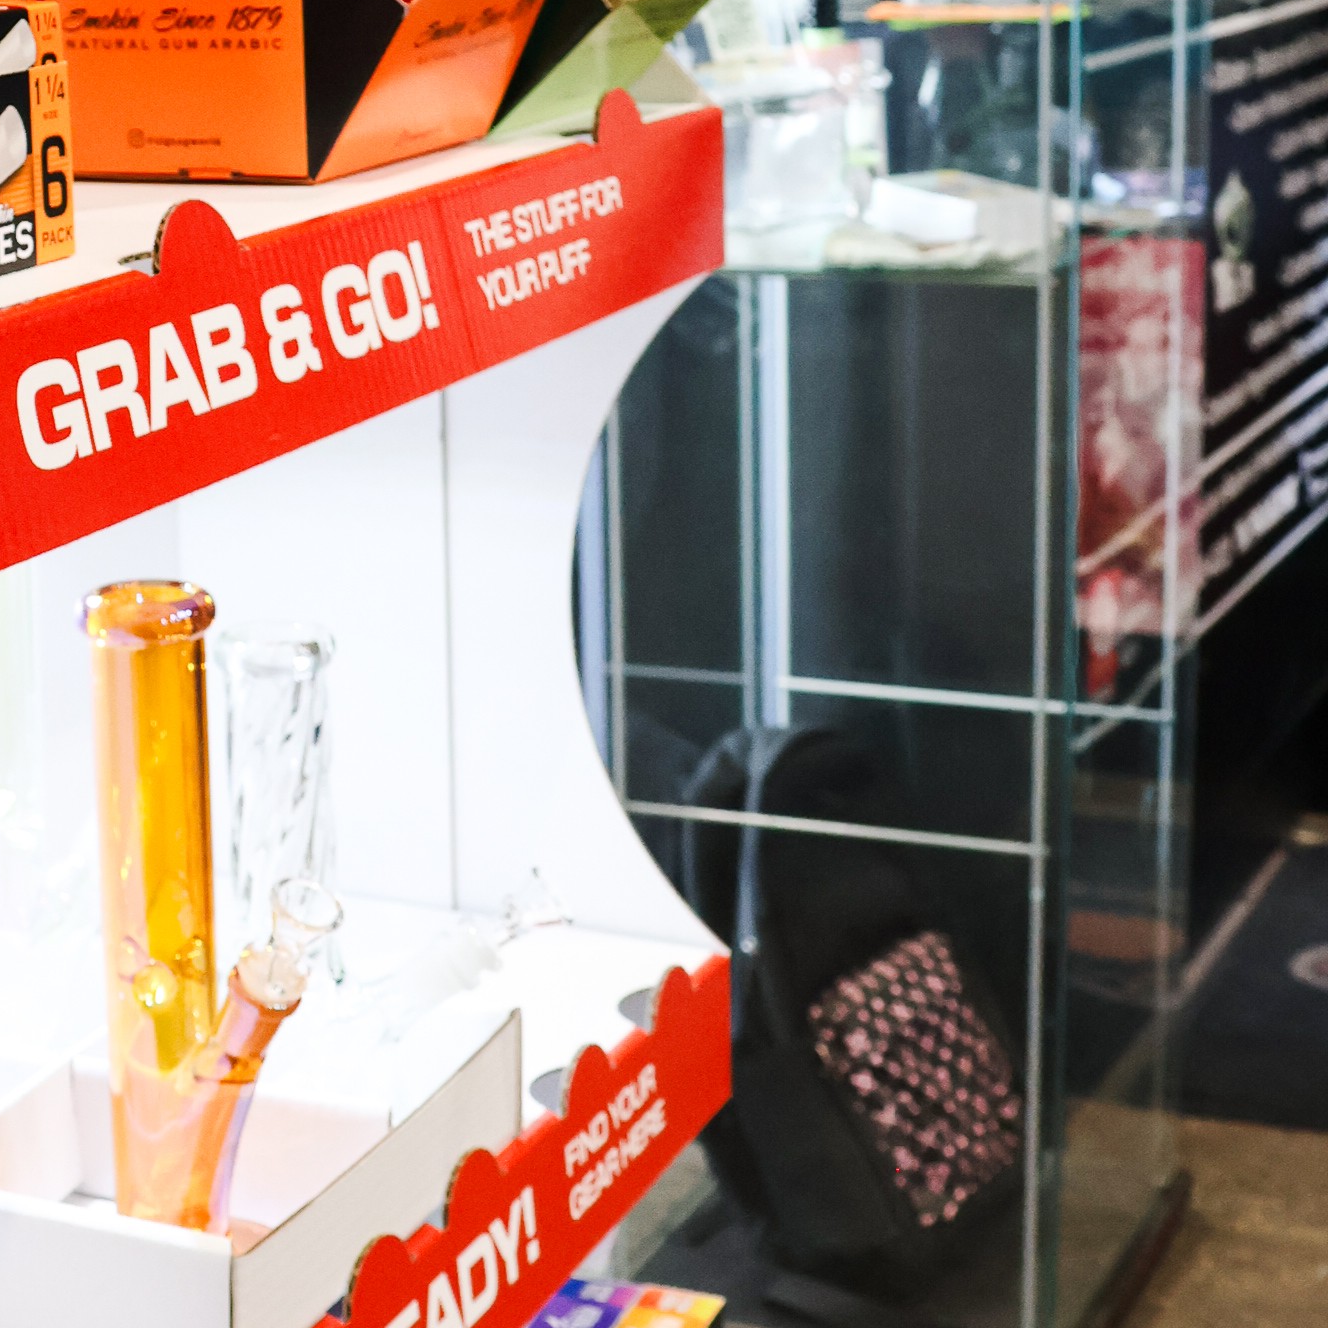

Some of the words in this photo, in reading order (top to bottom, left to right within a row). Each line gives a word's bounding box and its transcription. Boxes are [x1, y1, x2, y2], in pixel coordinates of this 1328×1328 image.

[66, 38, 150, 51] NATURAL
[209, 38, 282, 51] ARABIC
[226, 5, 283, 31] 1879
[41, 135, 68, 218] 6
[464, 209, 516, 258] THE
[512, 189, 580, 243] STUFF
[579, 175, 624, 221] FOR
[42, 226, 73, 249] PACK
[476, 257, 542, 311] YOUR
[537, 237, 591, 290] PUFF
[17, 301, 257, 471] GRAB
[269, 283, 322, 383] &
[324, 241, 441, 361] GO!
[564, 1110, 610, 1178] FIND
[608, 1063, 657, 1130] YOUR
[569, 1146, 621, 1220] GEAR
[619, 1098, 667, 1169] HERE
